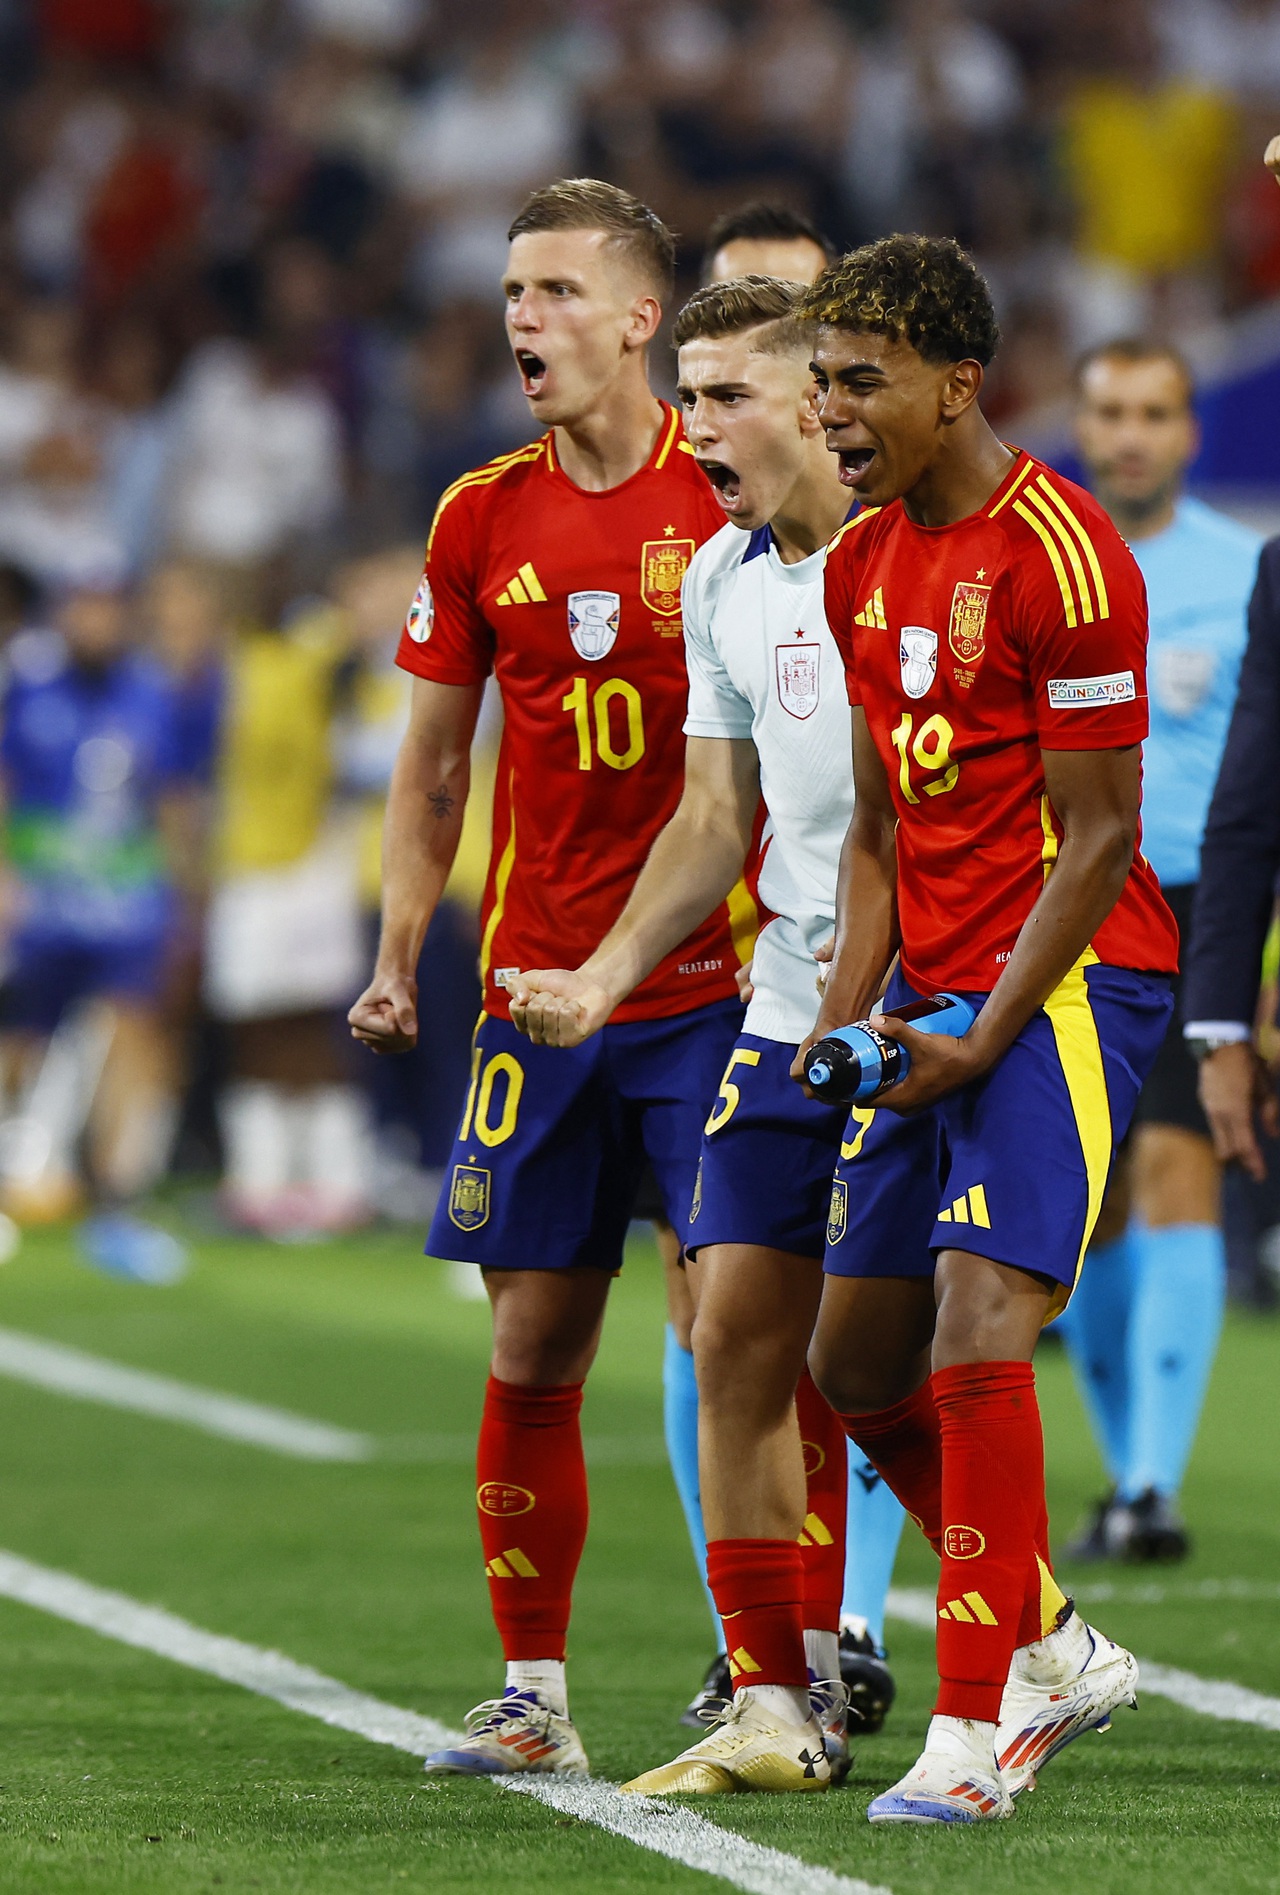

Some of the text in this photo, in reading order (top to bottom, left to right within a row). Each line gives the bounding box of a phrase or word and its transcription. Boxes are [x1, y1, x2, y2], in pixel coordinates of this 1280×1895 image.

[562, 677, 645, 771] 10
[1049, 681, 1068, 689] UEFA
[891, 713, 960, 804] 19
[459, 1047, 524, 1148] 10
[1028, 1693, 1094, 1725] F50
